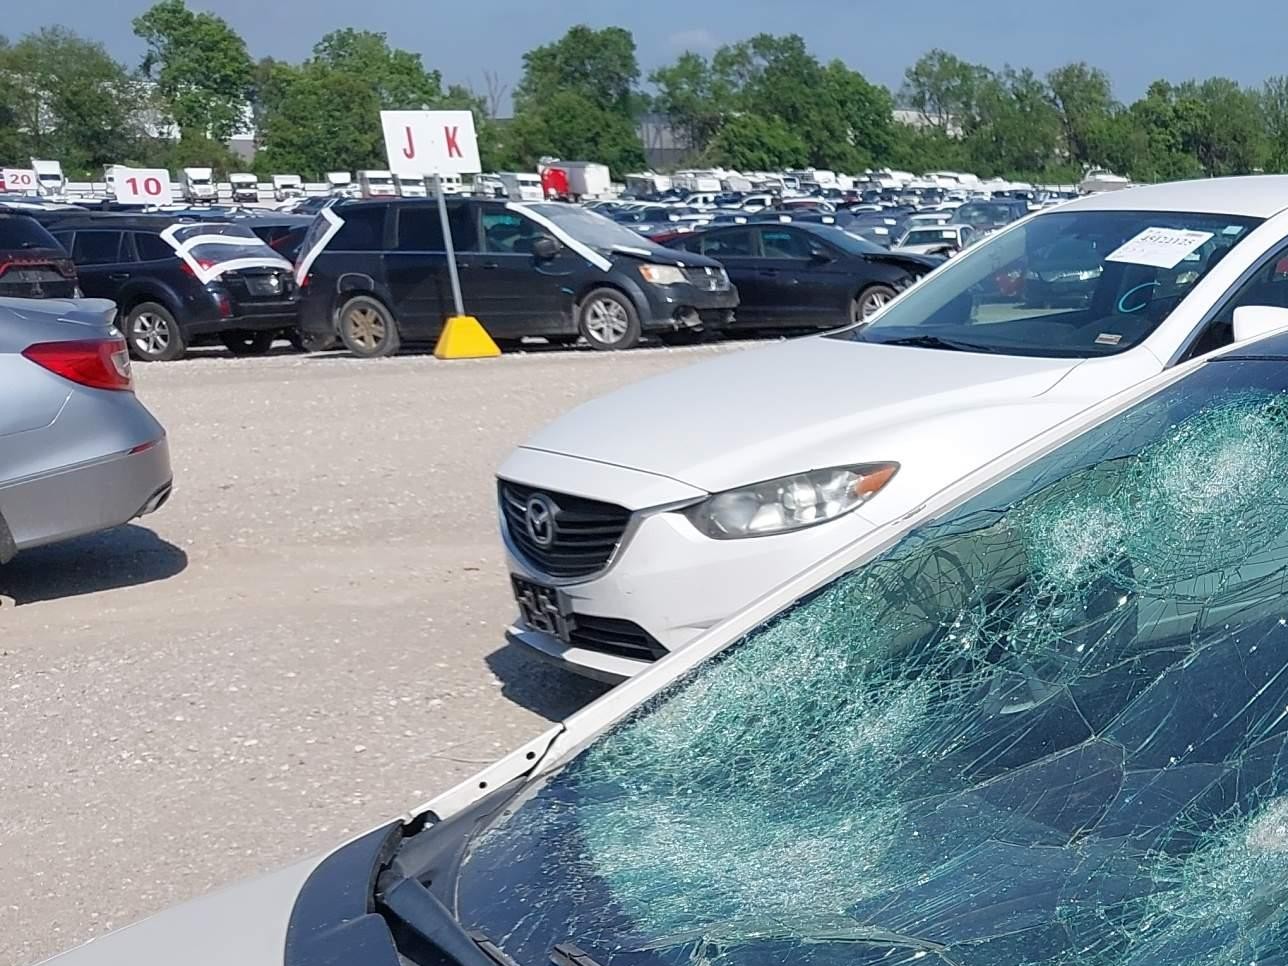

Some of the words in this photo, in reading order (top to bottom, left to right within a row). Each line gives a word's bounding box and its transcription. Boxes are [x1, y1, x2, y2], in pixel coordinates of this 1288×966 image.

[403, 126, 415, 159] J
[444, 126, 463, 158] K
[9, 174, 31, 185] 20
[126, 178, 162, 196] 10
[1118, 280, 1161, 313] C
